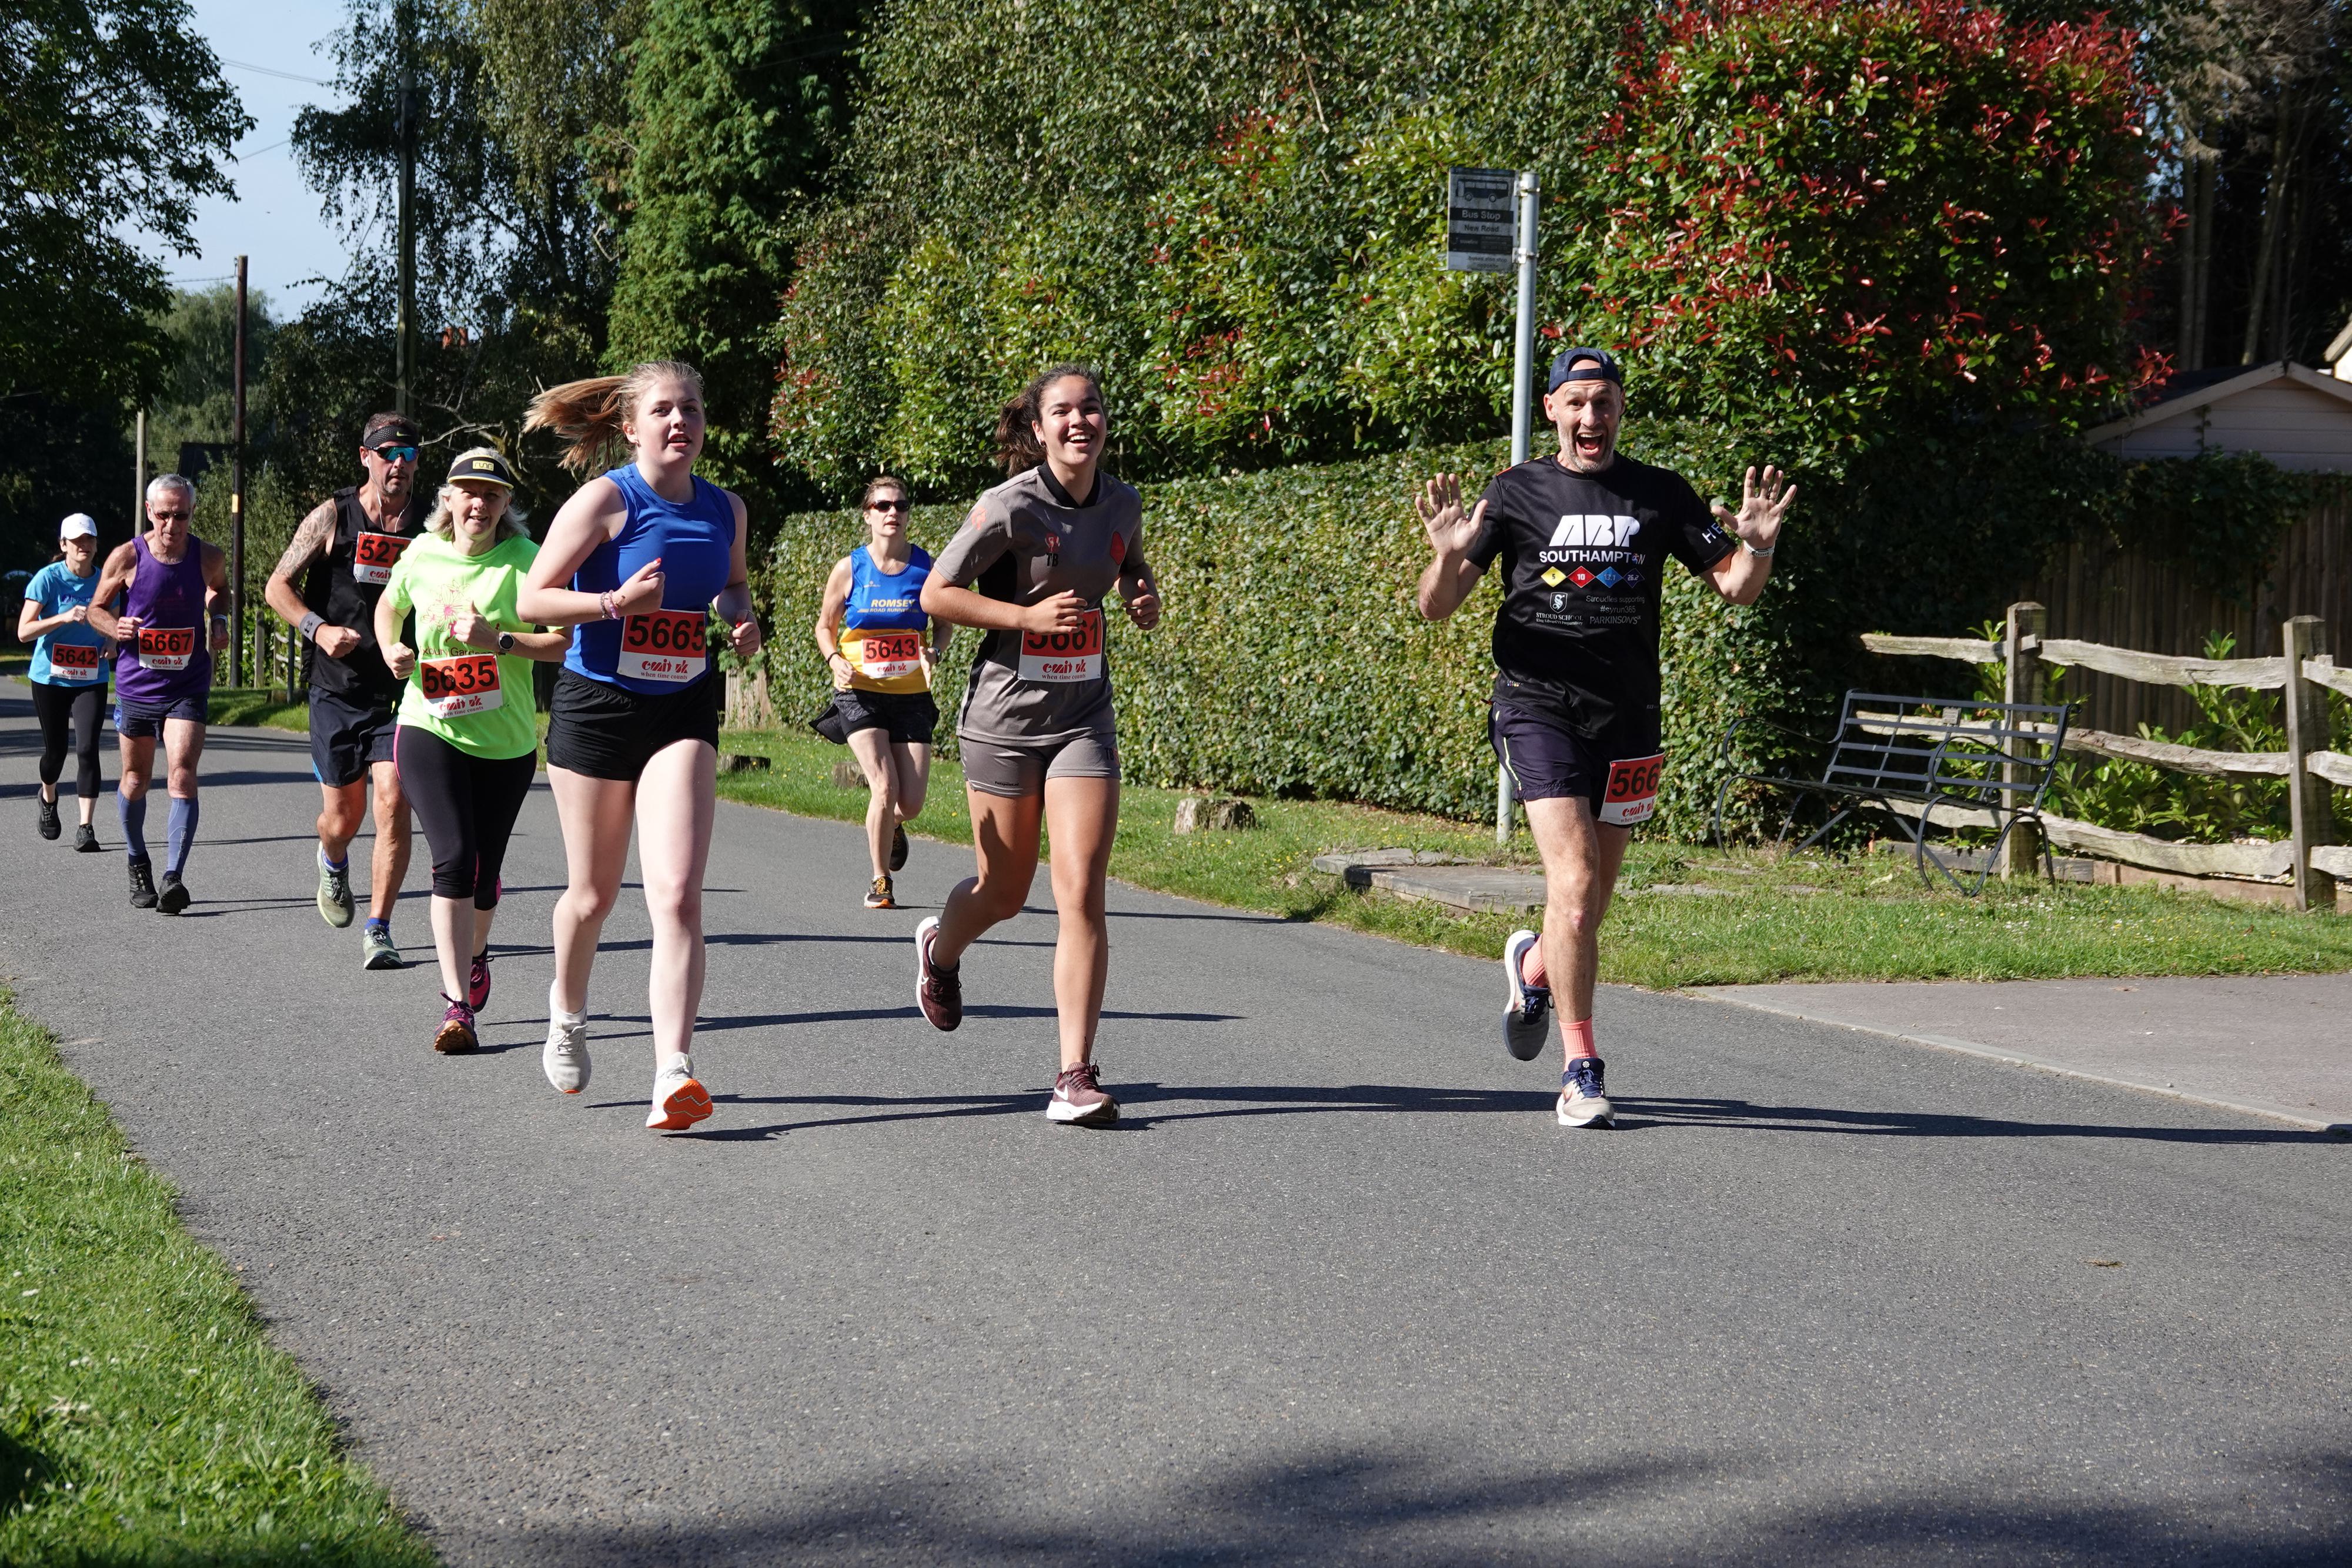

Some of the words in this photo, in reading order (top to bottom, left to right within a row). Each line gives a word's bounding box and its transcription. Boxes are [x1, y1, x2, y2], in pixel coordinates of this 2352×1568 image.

[1462, 210, 1478, 218] Bus
[1481, 211, 1500, 221] Stop
[1549, 514, 1641, 547] ABP
[871, 599, 916, 607] ROMSEY
[628, 615, 705, 651] 5665
[141, 633, 191, 651] 5667
[866, 638, 917, 659] 5643
[55, 648, 97, 665] 5642
[642, 658, 671, 672] emit
[676, 660, 688, 673] uk
[1043, 660, 1073, 673] emit
[1075, 659, 1086, 673] uk
[425, 661, 495, 694] 5635
[440, 698, 466, 710] emit
[469, 696, 482, 707] uk
